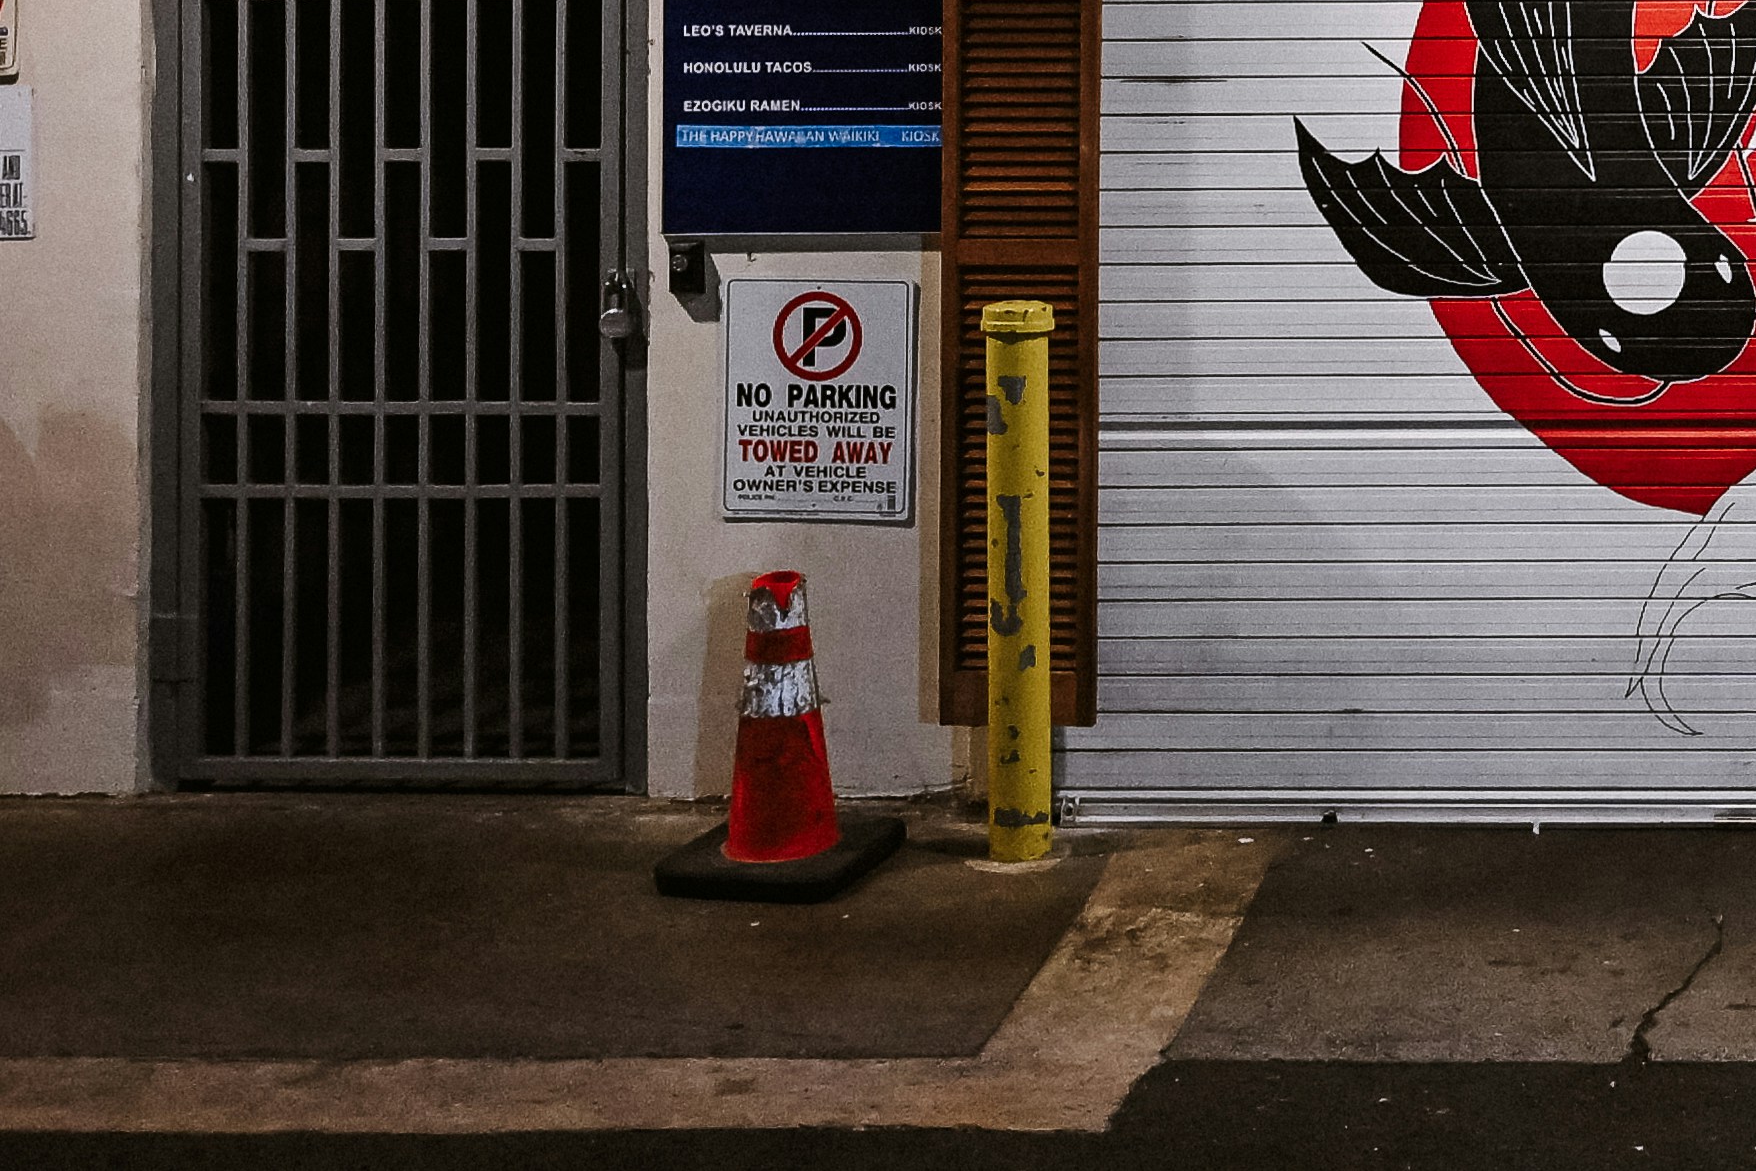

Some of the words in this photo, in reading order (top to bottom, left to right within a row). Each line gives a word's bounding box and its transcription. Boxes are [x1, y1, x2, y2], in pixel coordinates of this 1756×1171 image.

[683, 24, 724, 37] LEO'S
[728, 24, 793, 37] TAVERNA
[908, 26, 942, 35] KIOSK
[683, 62, 762, 74] HONOLULU
[765, 62, 813, 74] TACOS
[907, 63, 942, 72] KIOSK
[683, 99, 746, 112] EZOGIKU
[749, 99, 801, 112] RAMEN
[908, 101, 942, 111] KIOSK
[681, 129, 707, 142] THE
[710, 130, 753, 143] HAPPY
[755, 129, 825, 143] HAWAAN
[901, 130, 940, 142] KIOSK
[736, 382, 772, 408] NO
[787, 383, 897, 410] PARKING
[752, 409, 881, 424] UNAUTHORIZED
[736, 424, 819, 437] VEHICLES
[826, 425, 867, 438] WILL
[872, 426, 896, 439] BE
[738, 439, 819, 463] TOWED
[831, 440, 893, 465] AWAY
[764, 465, 787, 478] AT
[793, 465, 867, 479] VEHICLE
[733, 479, 814, 493] OWNER'S
[817, 480, 897, 495] EXPENSE
